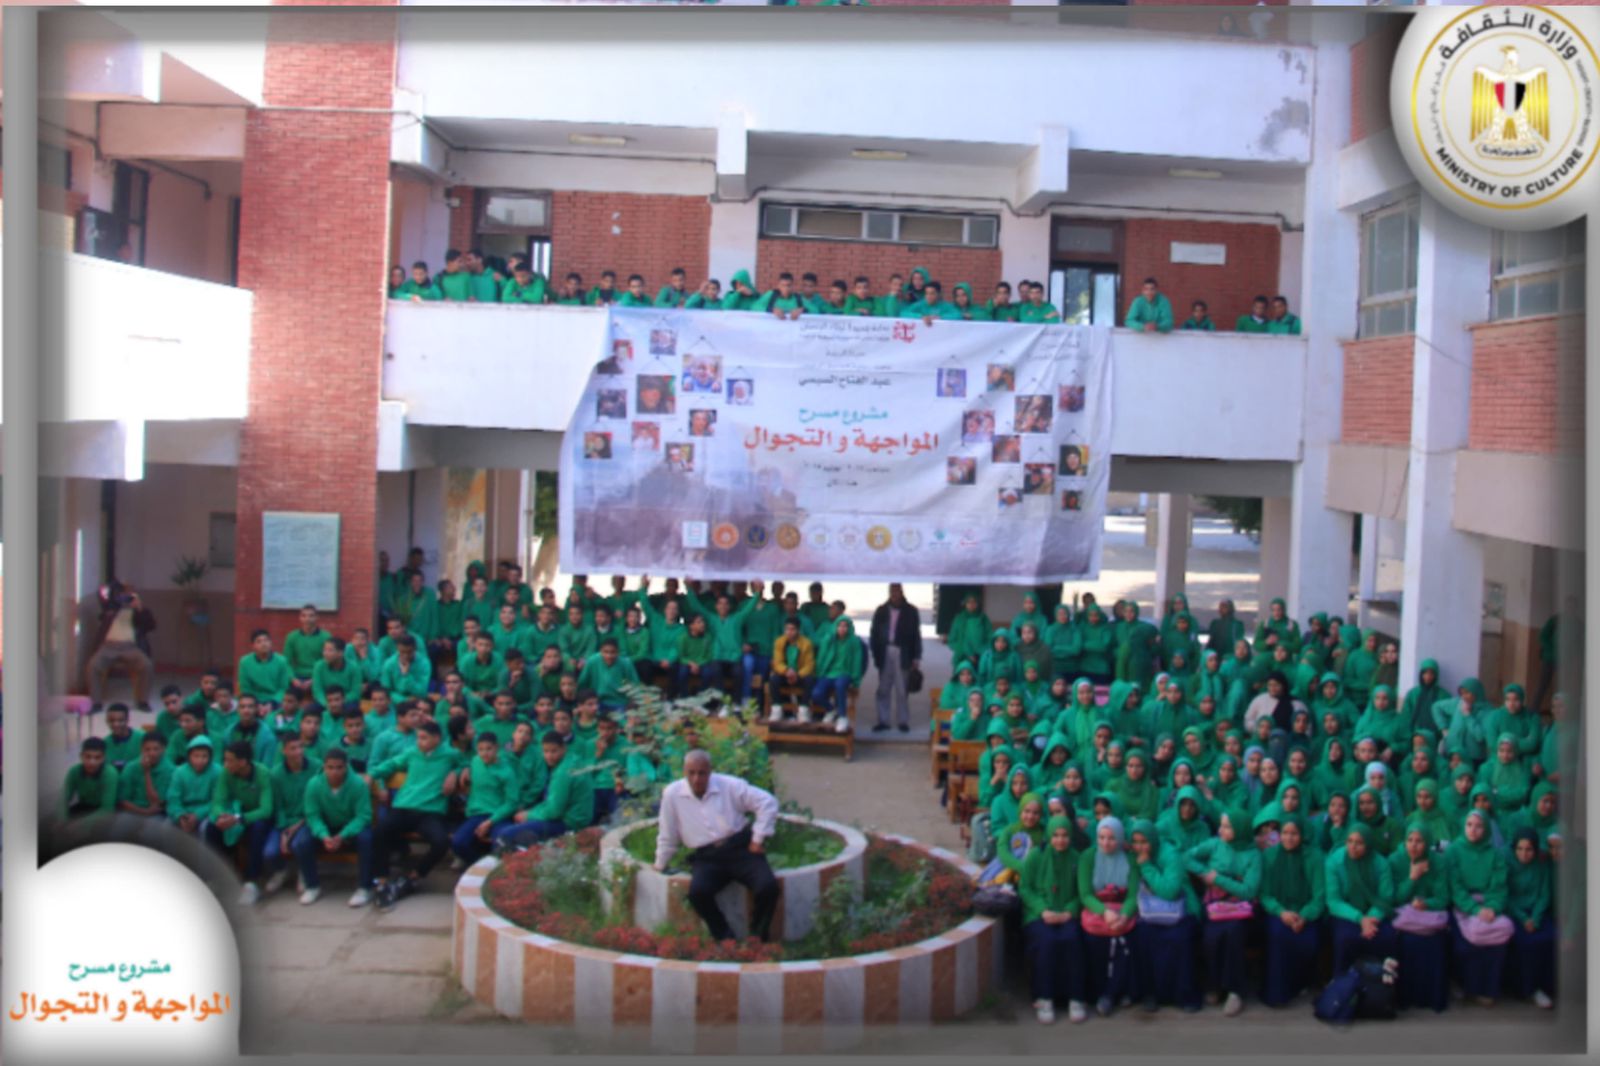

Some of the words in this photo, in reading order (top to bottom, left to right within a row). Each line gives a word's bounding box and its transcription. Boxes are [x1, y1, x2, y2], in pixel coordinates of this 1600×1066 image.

[798, 408, 840, 423] مسرح
[842, 406, 889, 425] مشروع
[853, 428, 939, 456] المواجهة
